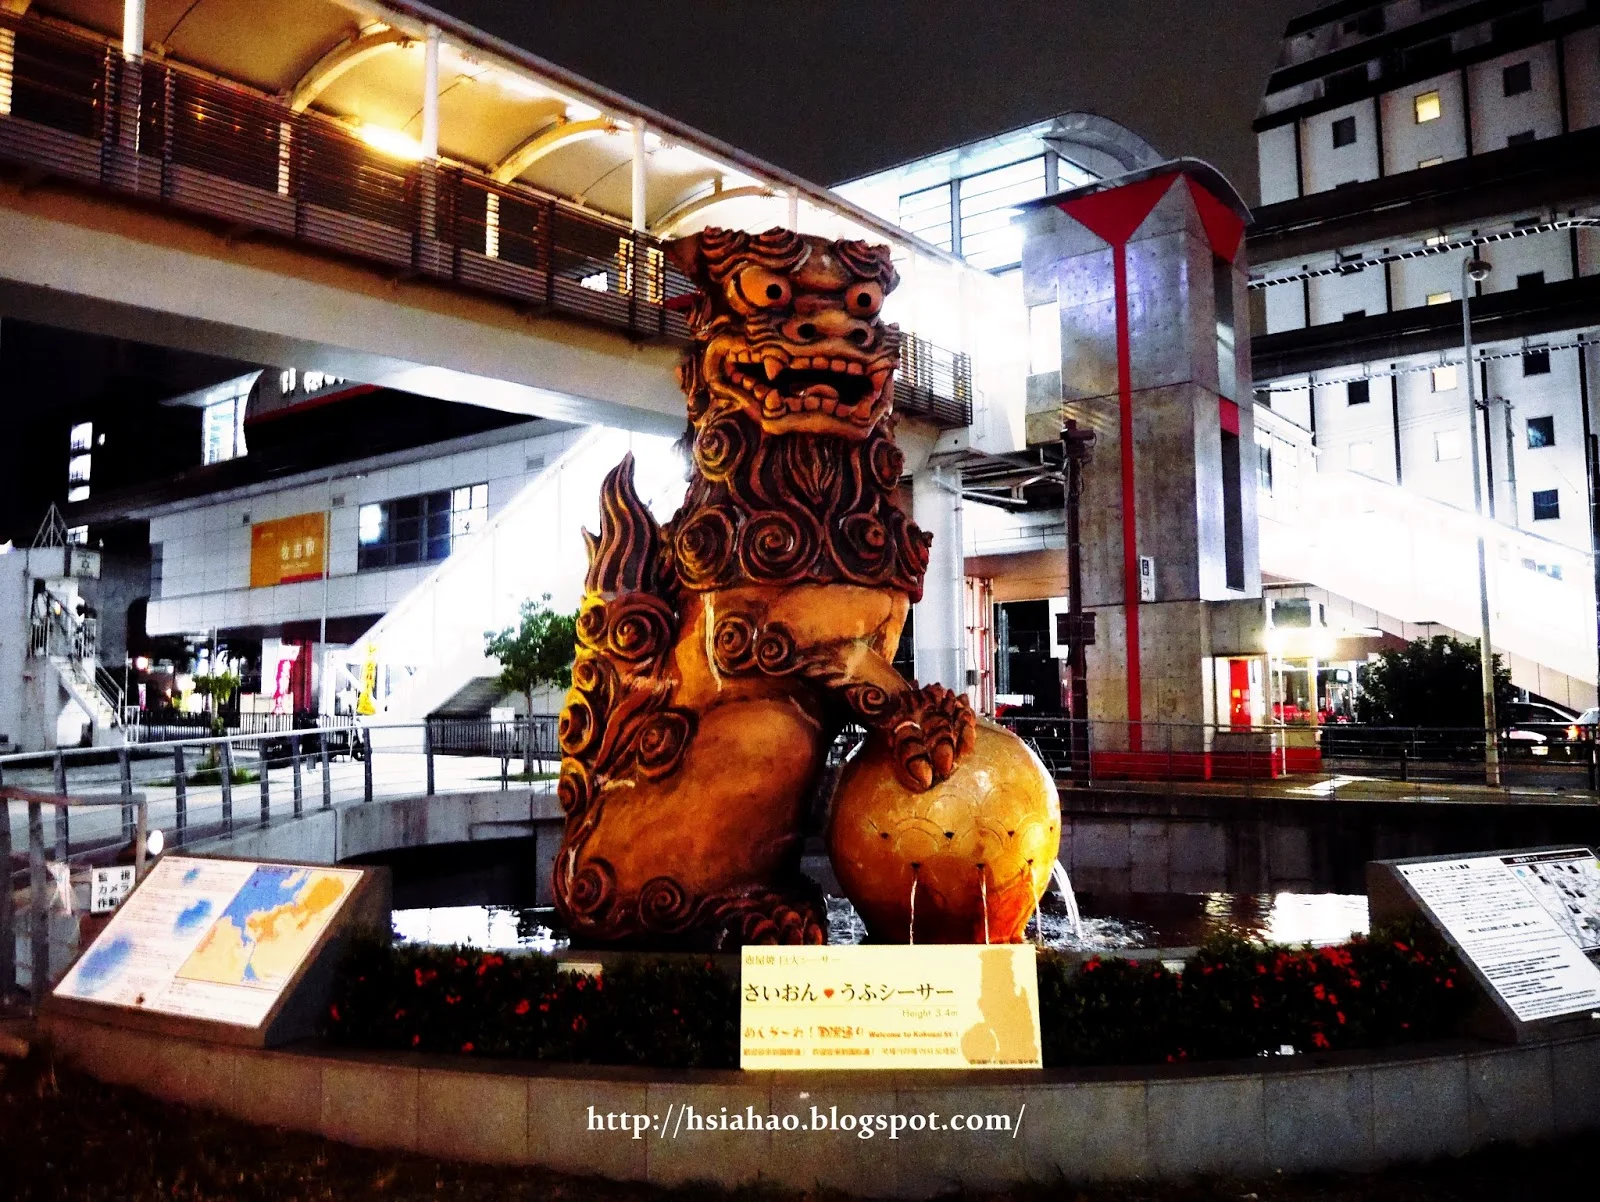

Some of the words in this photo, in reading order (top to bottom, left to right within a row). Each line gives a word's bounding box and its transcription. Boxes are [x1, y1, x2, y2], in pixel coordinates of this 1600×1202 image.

[99, 883, 130, 895] カメラ
[744, 983, 818, 1002] さいおん
[841, 983, 954, 1002] うふシーサー
[902, 1009, 931, 1019] Height
